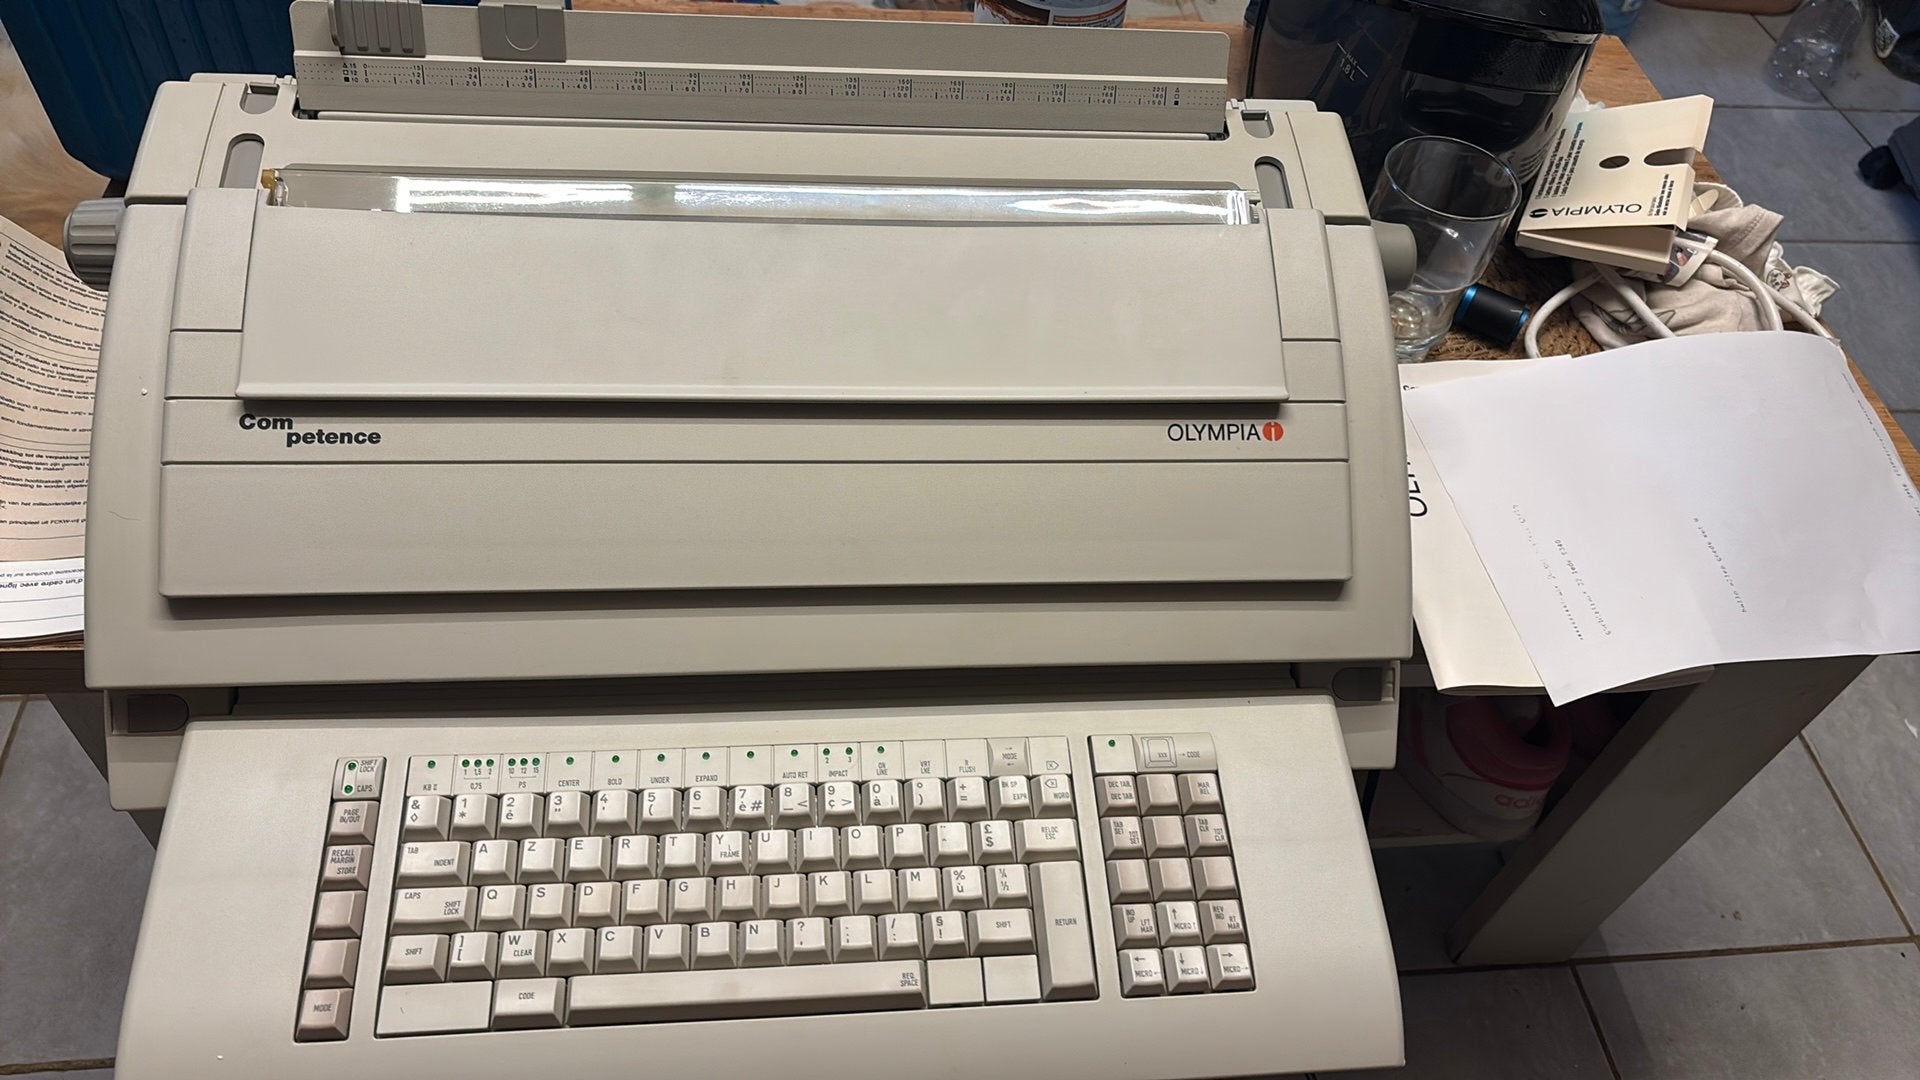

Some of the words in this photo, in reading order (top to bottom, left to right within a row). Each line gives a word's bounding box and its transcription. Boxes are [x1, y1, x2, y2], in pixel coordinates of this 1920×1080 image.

[1551, 203, 1642, 217] OLYMPIA
[239, 413, 293, 430] Com
[1167, 423, 1261, 442] OLYMPIA
[286, 429, 381, 448] petence
[1002, 752, 1017, 760] MODE
[876, 768, 888, 776] LINE
[558, 779, 580, 787] CENTER
[608, 778, 622, 786] BOLD
[650, 776, 670, 784] UNDER
[696, 774, 718, 782] EXPAND
[356, 784, 373, 793] CAPS
[1010, 780, 1018, 788] SP
[693, 790, 701, 800] 6
[739, 789, 746, 798] 7
[784, 788, 792, 797] 8
[828, 786, 836, 796] 9
[1054, 792, 1070, 800] WORD
[554, 796, 562, 806] 3
[600, 794, 608, 804] 4
[648, 792, 656, 802] 5
[873, 796, 881, 806] à
[410, 800, 420, 810] &
[462, 798, 467, 808] 1
[506, 797, 515, 808] 2
[739, 802, 746, 812] è
[751, 800, 762, 812] #
[828, 799, 835, 808] ç
[344, 808, 359, 816] PAGE
[506, 810, 514, 820] é
[340, 816, 360, 824] IN/OUT
[851, 829, 861, 839] O
[896, 828, 904, 837] P
[984, 824, 992, 834] £
[669, 837, 678, 846] T
[716, 835, 724, 844] Y
[761, 833, 770, 842] U
[986, 836, 994, 848] $
[527, 842, 536, 852] Z
[575, 840, 583, 850] E
[621, 839, 631, 848] R
[479, 844, 488, 854] A
[720, 850, 740, 858] FRAME
[864, 874, 872, 883] L
[911, 872, 920, 881] M
[954, 870, 965, 880] %
[727, 880, 735, 890] H
[774, 878, 780, 888] J
[819, 876, 828, 886] K
[584, 886, 593, 896] D
[632, 884, 641, 894] F
[679, 882, 688, 892] G
[956, 883, 964, 893] ù
[487, 890, 498, 900] Q
[536, 887, 546, 898] S
[797, 922, 805, 931] ?
[936, 916, 943, 927] §
[996, 921, 1011, 929] SHIFT
[1055, 918, 1077, 926] RETURN
[655, 929, 663, 939] V
[701, 928, 710, 937] B
[750, 924, 758, 934] N
[508, 935, 520, 946] W
[557, 933, 566, 943] X
[605, 931, 615, 941] C
[404, 948, 422, 956] SHIFT
[514, 949, 532, 957] CLEAR
[900, 979, 918, 987] SPACE
[519, 992, 535, 1000] CODE
[314, 1004, 332, 1012] MODE
